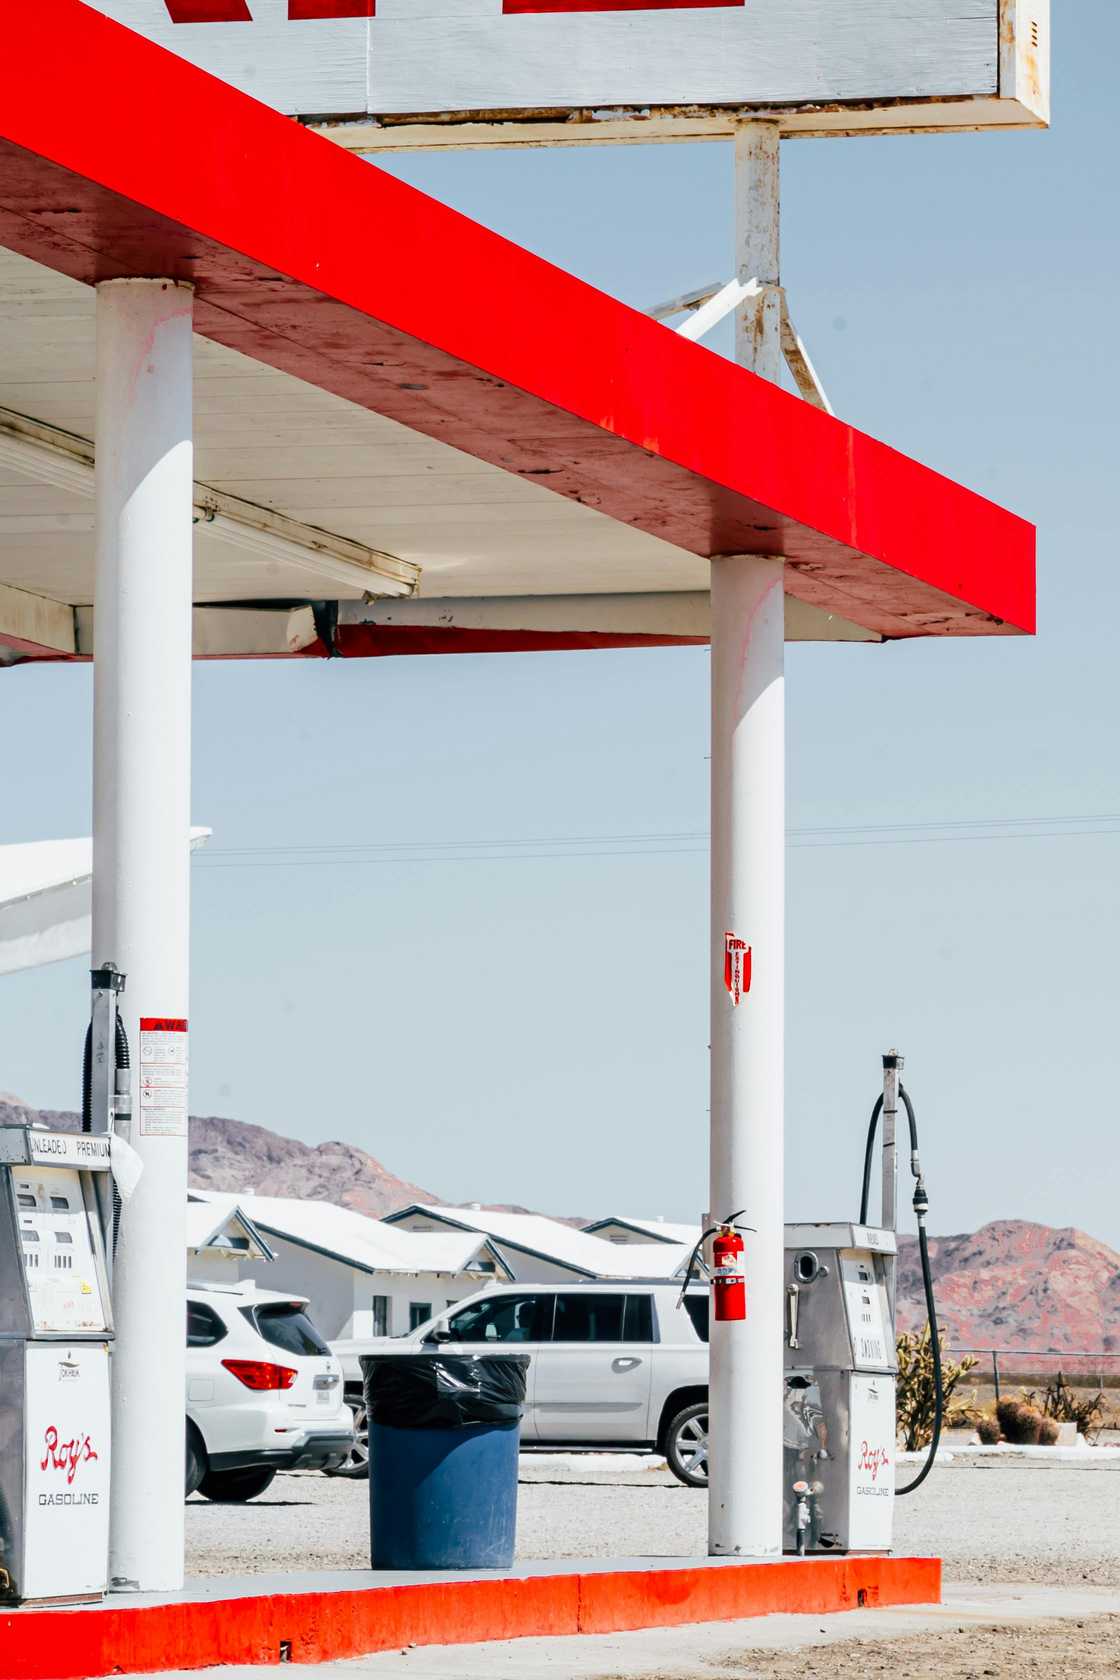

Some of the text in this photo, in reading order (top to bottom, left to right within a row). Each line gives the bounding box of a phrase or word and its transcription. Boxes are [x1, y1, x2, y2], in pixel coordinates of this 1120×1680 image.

[728, 939, 747, 950] FIRE
[40, 1424, 98, 1485] Roy's
[38, 1492, 99, 1506] GASOLINE
